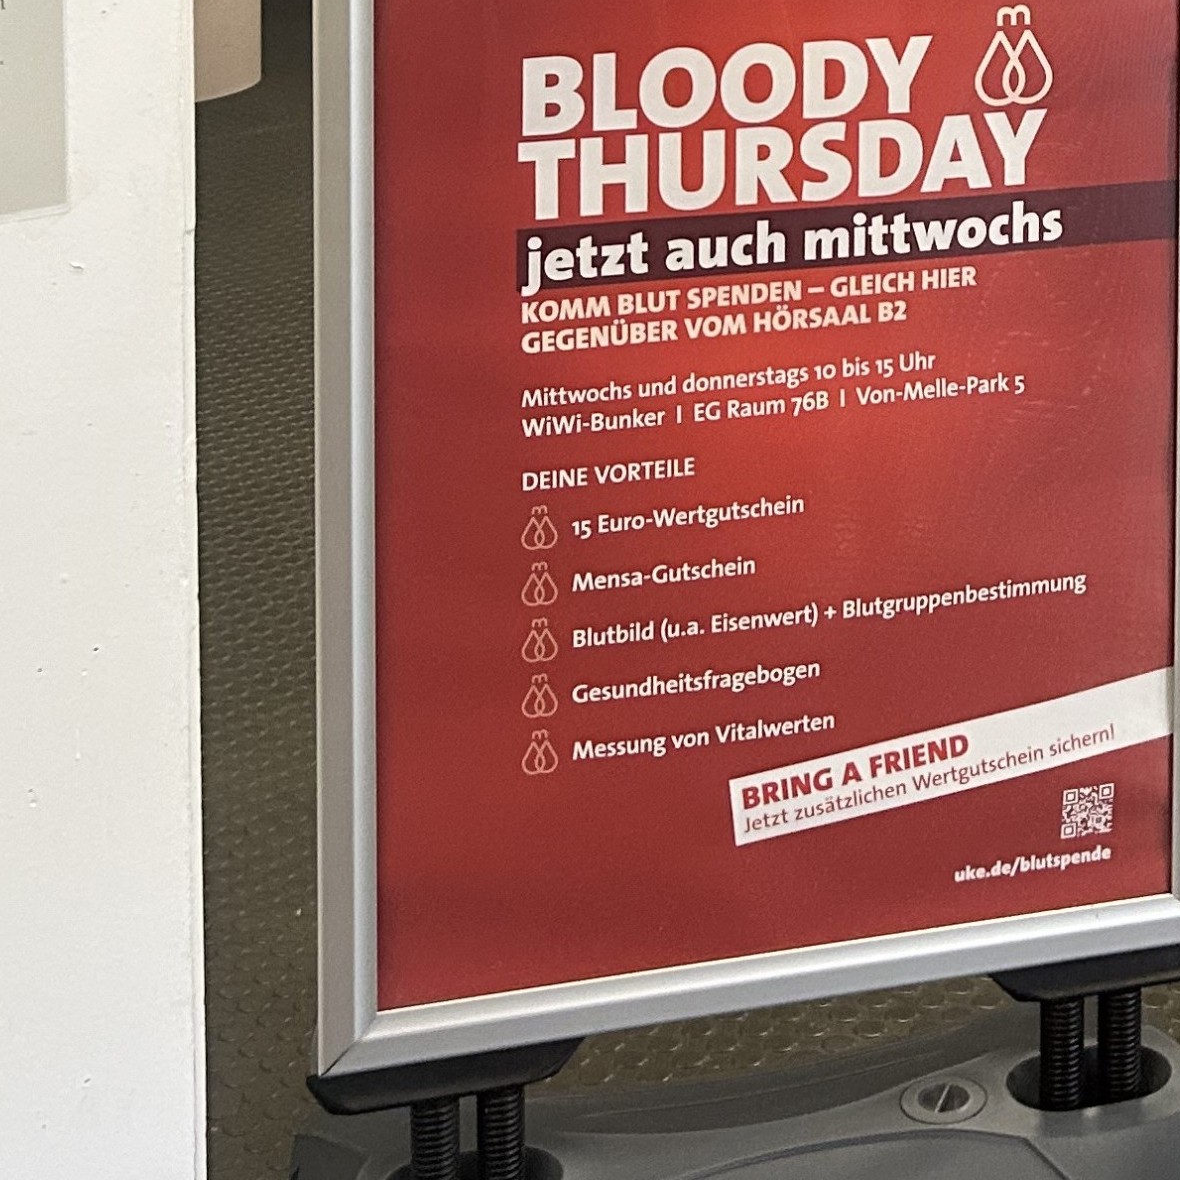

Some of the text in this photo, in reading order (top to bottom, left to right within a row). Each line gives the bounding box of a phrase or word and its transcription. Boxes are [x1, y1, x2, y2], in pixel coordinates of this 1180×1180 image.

[522, 35, 933, 136] BLOODY
[518, 108, 1047, 220] THURSDAY
[521, 200, 1062, 297] jetzt auch mittwochs
[522, 296, 611, 324] KOMM
[618, 290, 681, 315] BLUT
[687, 280, 802, 309] SPENDEN
[830, 271, 915, 298] GLEICH
[922, 266, 977, 290] HIER
[521, 300, 907, 354] GEGENÜBER VOM HÖRSAAL B2
[522, 351, 936, 407] Mittwochs und donnerstags 10 bis 15 Uhr
[522, 408, 665, 437] WiWi-Bunker
[694, 401, 721, 422] EG
[727, 399, 785, 418] Raum
[791, 391, 829, 417] 76B
[856, 372, 1010, 405] Von-Melle-Park
[1015, 375, 1025, 394] 5
[522, 457, 695, 491] DEINE VORTEILE
[572, 495, 804, 539] 15 Euro-Wertgutschein
[572, 556, 755, 592] Mensa-Gutschein
[573, 621, 654, 648] Blutbild
[661, 618, 705, 643] (u.a.
[711, 602, 818, 633] Eisenwert)
[843, 575, 1086, 619] Blutgruppenbestimmung
[572, 663, 820, 703] Gesundheitsfragebogen
[573, 715, 834, 760] Messung von Vitalwerten
[742, 735, 968, 810] BRING A FRIEND
[745, 724, 1113, 833] Jetzt zusätzlichen Wertgutschein sichern!
[954, 845, 1111, 882] uke.de/blutspende
